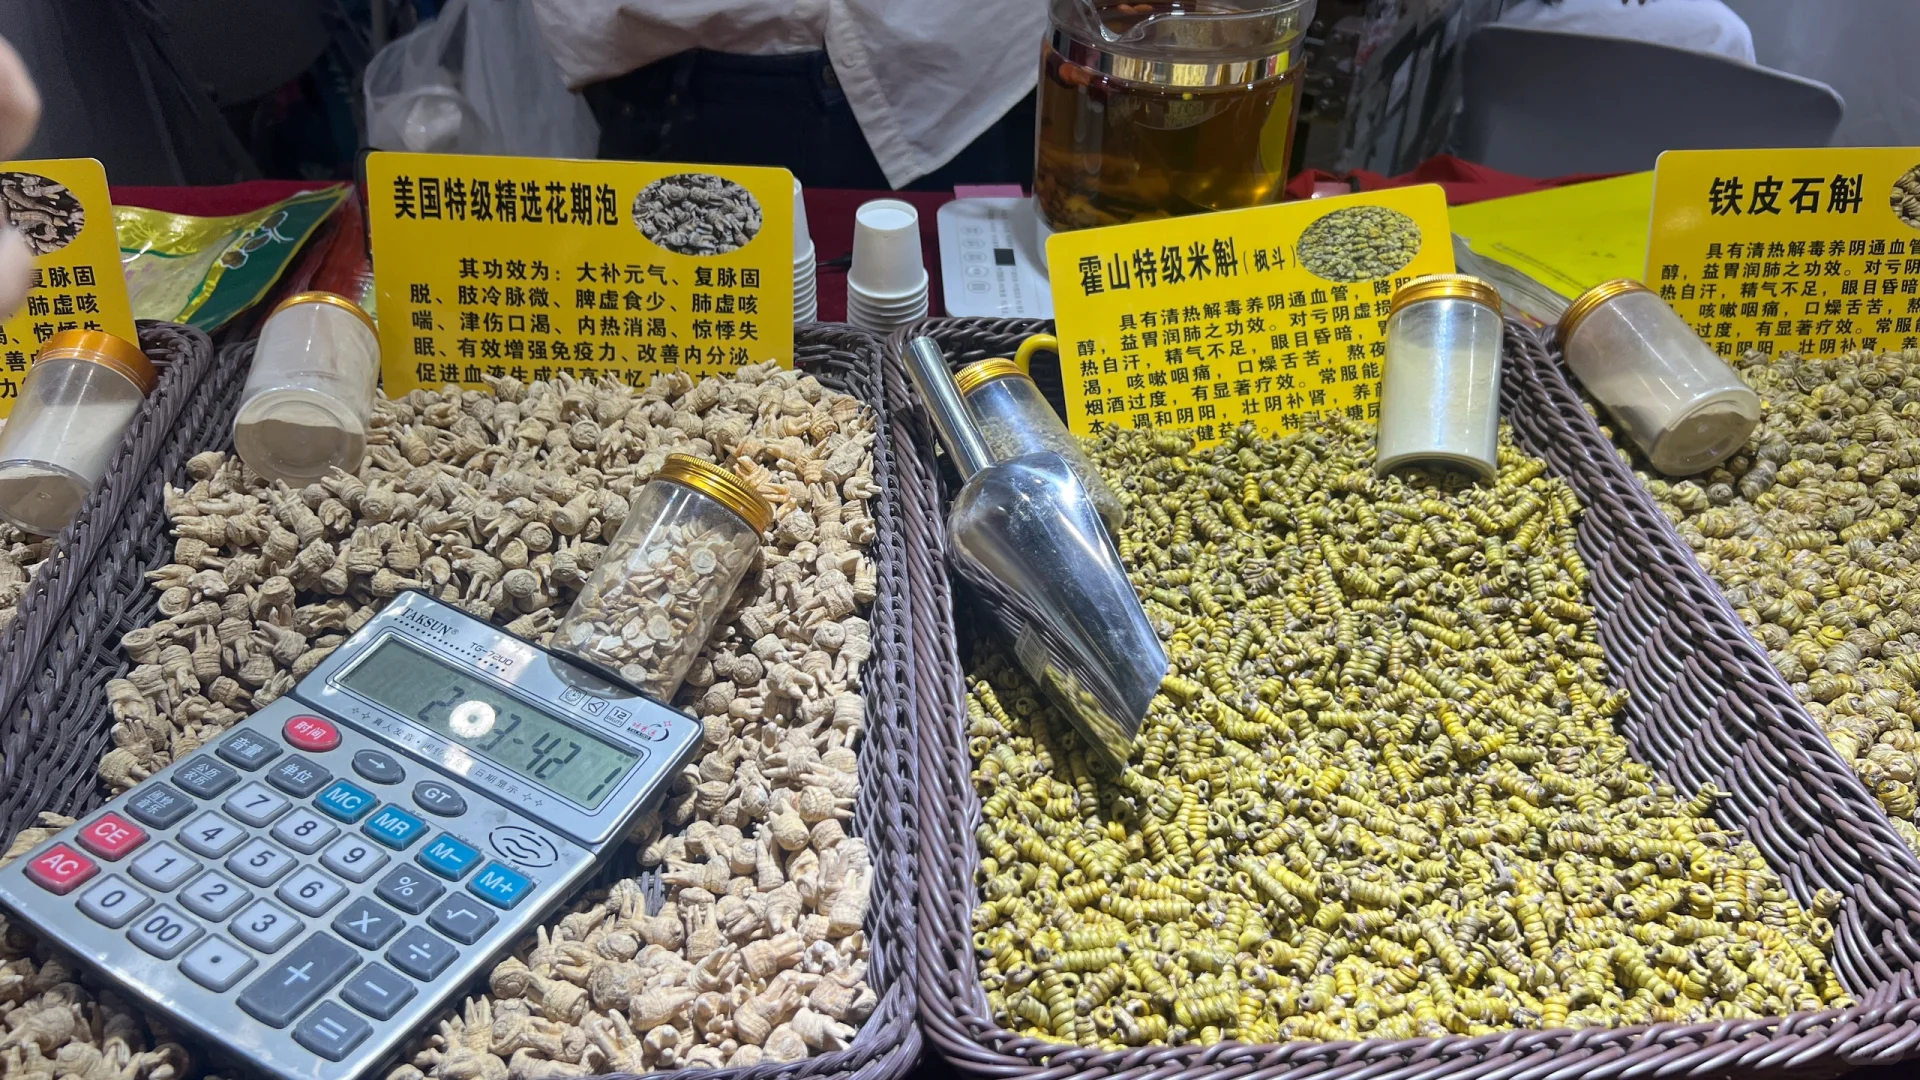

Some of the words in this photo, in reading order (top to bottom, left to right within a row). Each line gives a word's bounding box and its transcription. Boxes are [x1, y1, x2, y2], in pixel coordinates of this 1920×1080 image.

[393, 175, 619, 226] 美国特级精选花期泡
[1708, 173, 1864, 216] 铁皮石斛
[1119, 273, 1433, 331] 具有清热解毒养阴通血管，降
[470, 642, 514, 666] TG-7200
[294, 720, 326, 740] 时间
[229, 736, 264, 758] 音量
[281, 763, 313, 784] 单位
[245, 794, 271, 808] 7
[325, 786, 362, 809] MC
[424, 787, 452, 804] GT
[94, 821, 129, 844] CE
[294, 820, 318, 837] 8
[374, 812, 410, 836] MR
[201, 827, 224, 842] 4
[41, 853, 79, 875] AC
[154, 858, 177, 873] 1
[249, 850, 276, 867] 5
[342, 847, 367, 864] 9
[299, 881, 324, 898] 6
[479, 871, 513, 894] M+
[100, 890, 126, 908] 0
[200, 883, 228, 903] 2
[143, 915, 183, 942] 00
[251, 914, 277, 932] 3
